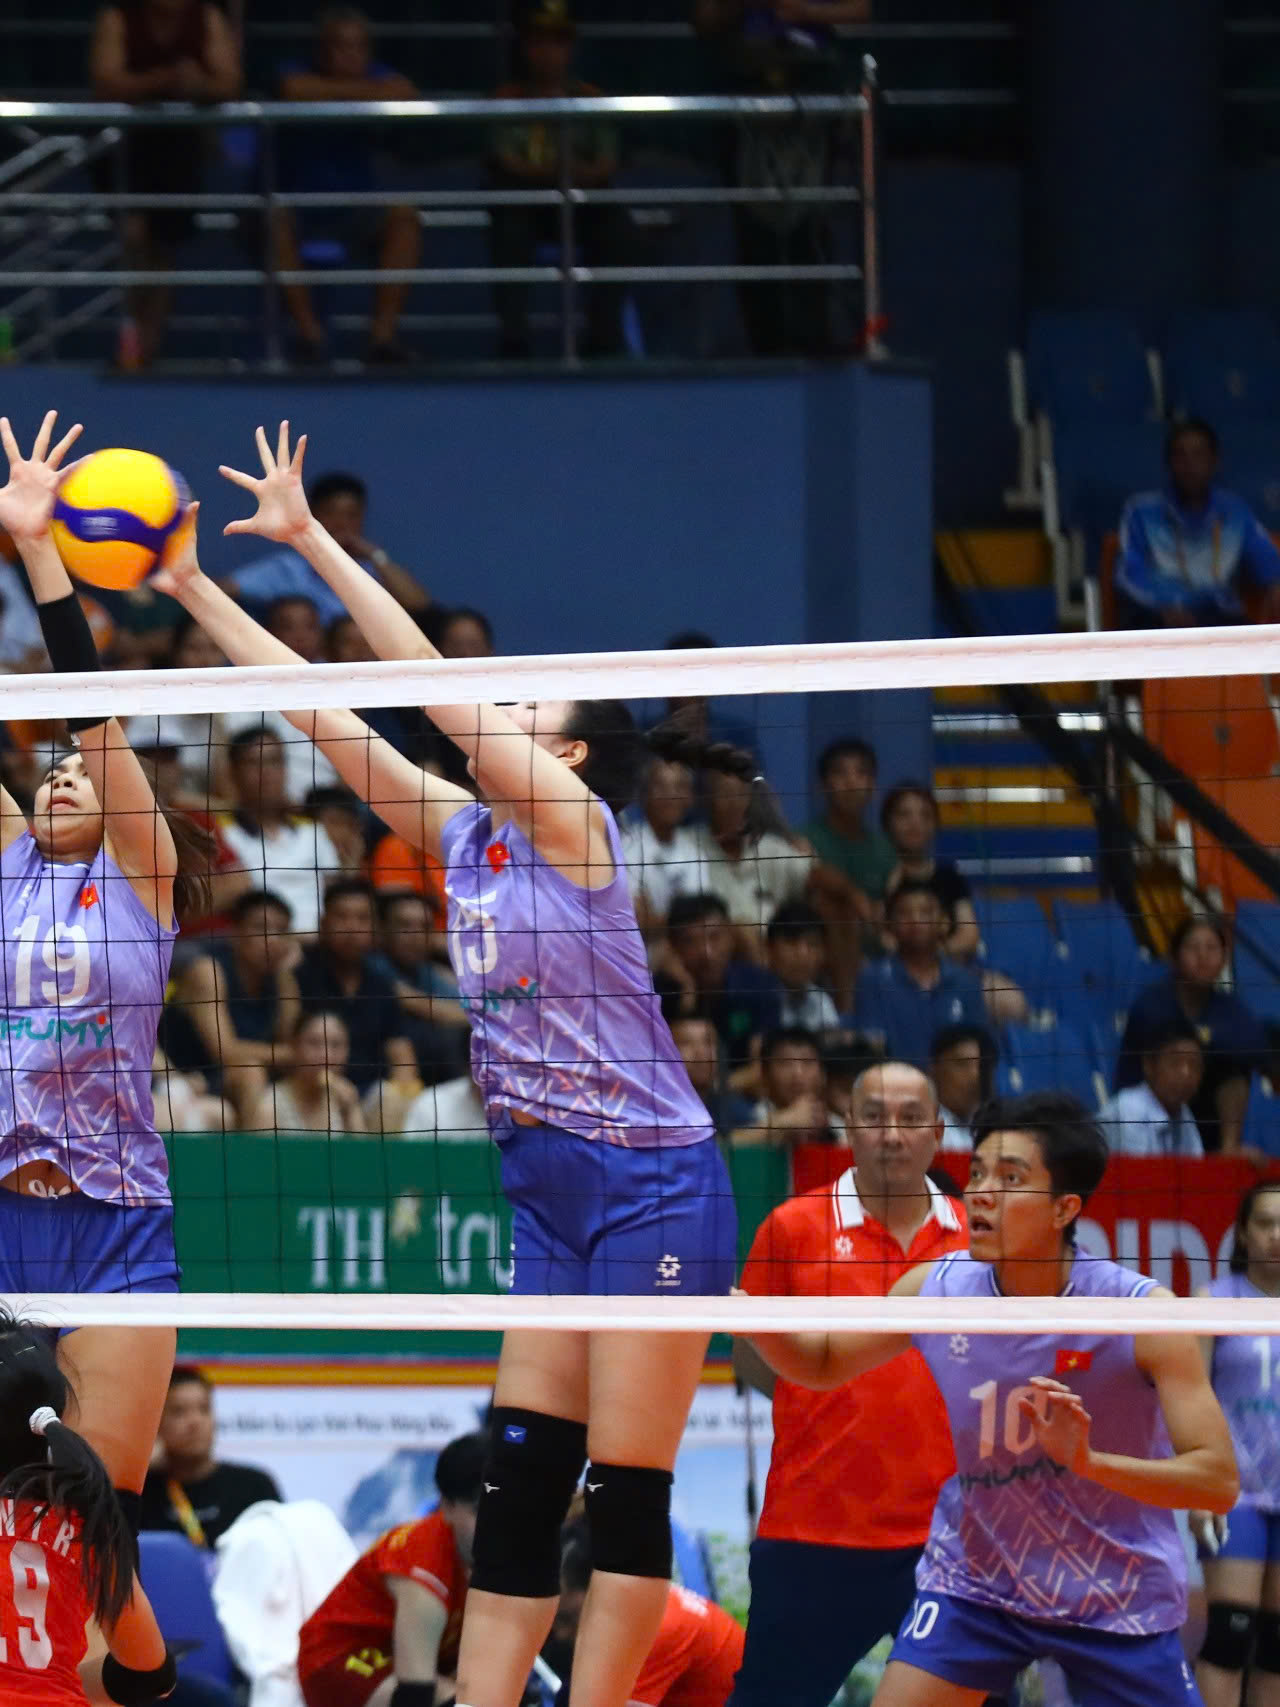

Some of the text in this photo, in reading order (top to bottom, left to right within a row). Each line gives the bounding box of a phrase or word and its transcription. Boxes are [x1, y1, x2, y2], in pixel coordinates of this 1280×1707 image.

[13, 913, 91, 1007] 19
[295, 1205, 386, 1289] TH
[969, 1379, 1050, 1460] 10
